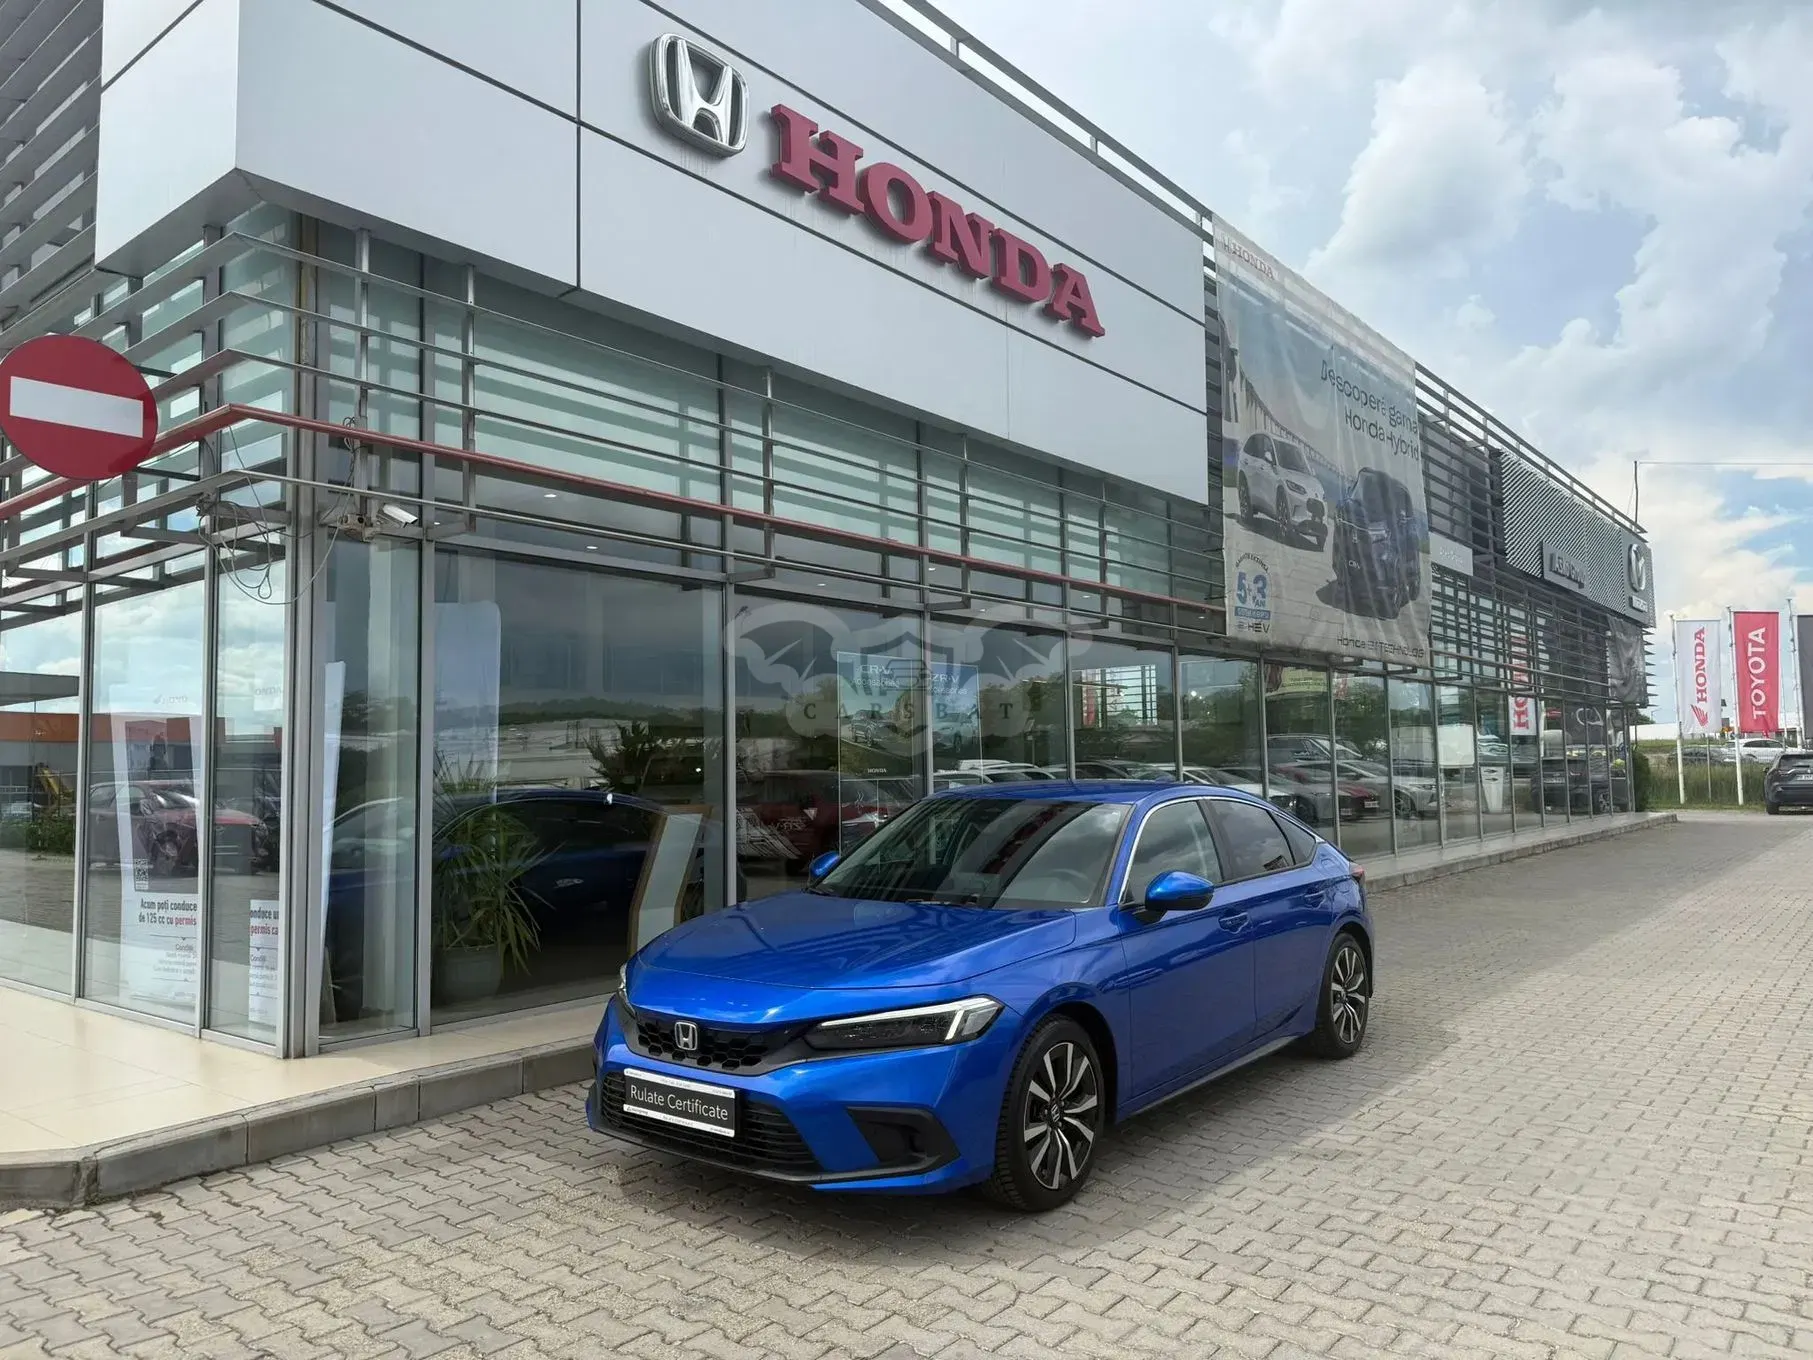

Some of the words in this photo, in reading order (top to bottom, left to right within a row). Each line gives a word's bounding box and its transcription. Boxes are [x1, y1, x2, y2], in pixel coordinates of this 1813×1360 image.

[769, 103, 1106, 338] HONDA
[1344, 404, 1386, 442] Honda
[1694, 626, 1708, 704] HONDA
[1747, 626, 1767, 720] TOYOTA
[138, 913, 146, 923] de
[146, 912, 157, 924] 125
[158, 916, 166, 925] cc
[166, 915, 174, 925] cu
[174, 915, 197, 927] permis
[140, 898, 157, 910] Acum
[170, 900, 198, 912] conduce
[630, 1084, 665, 1106] Rulate
[667, 1094, 729, 1121] Certificate
